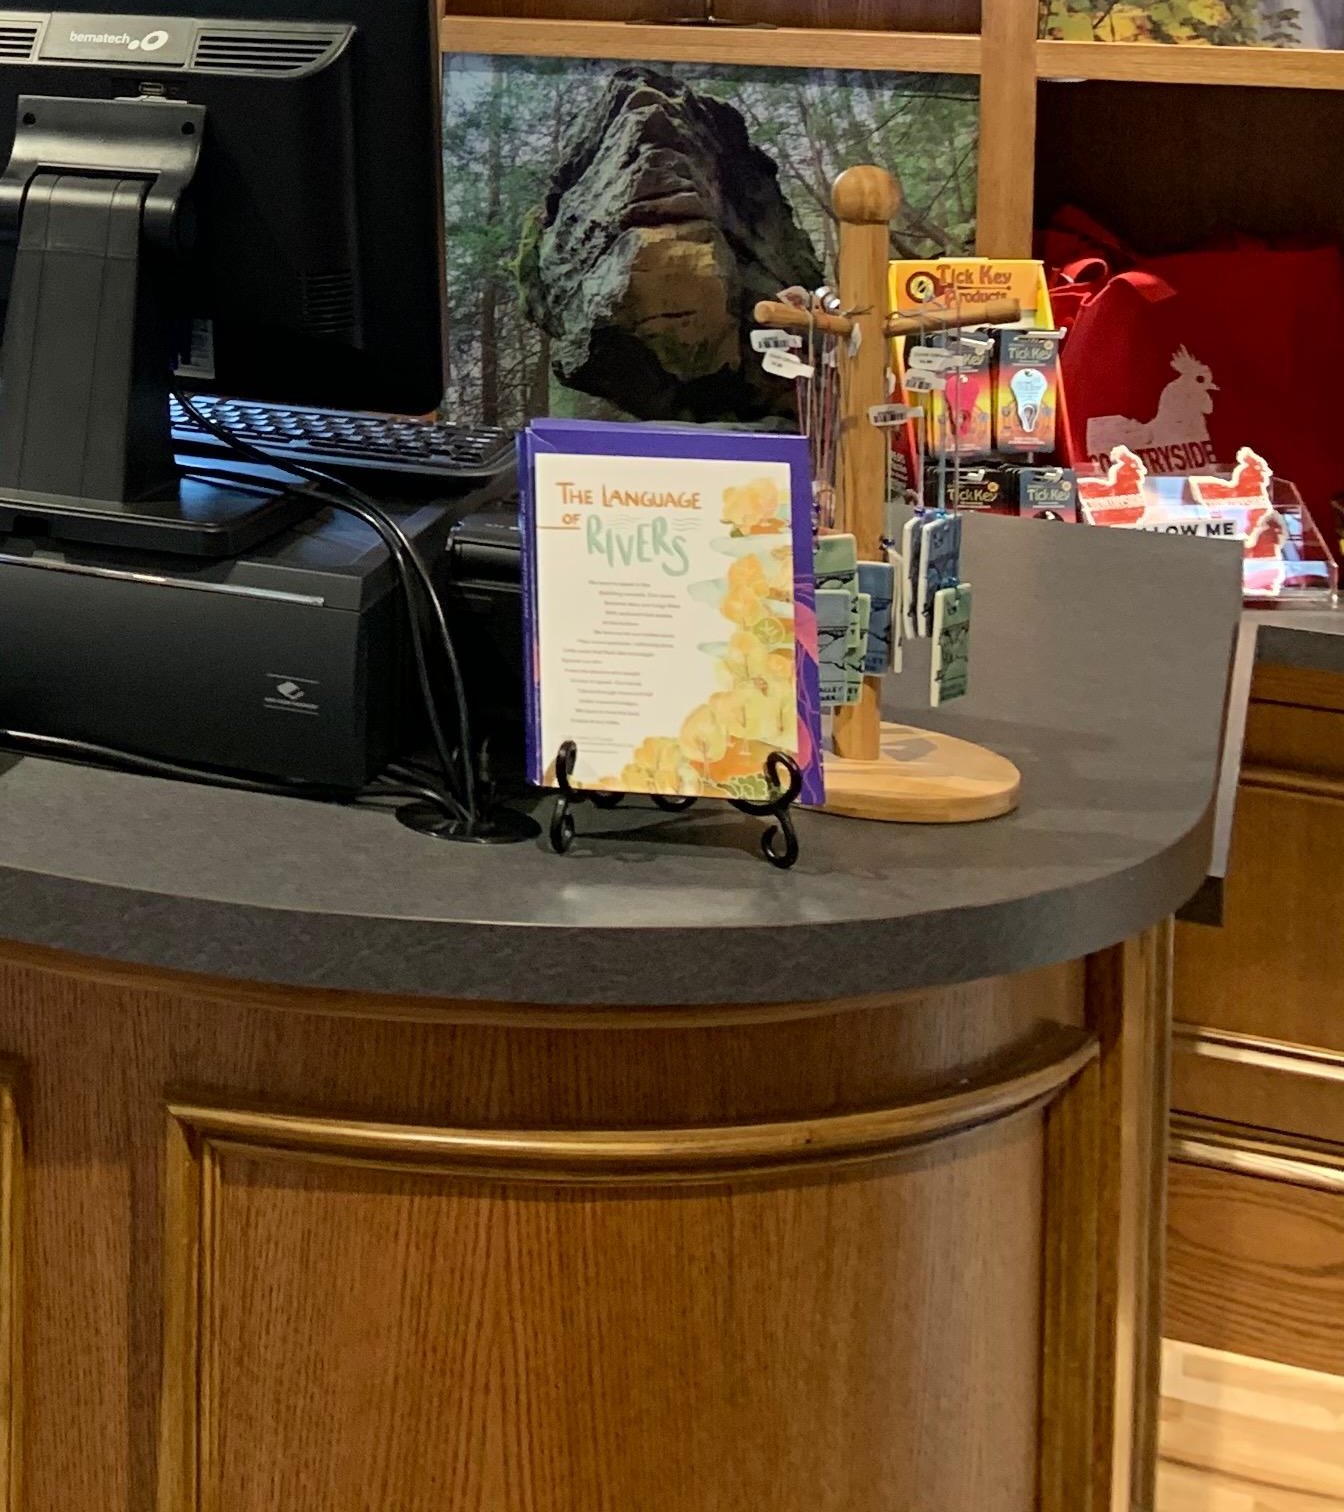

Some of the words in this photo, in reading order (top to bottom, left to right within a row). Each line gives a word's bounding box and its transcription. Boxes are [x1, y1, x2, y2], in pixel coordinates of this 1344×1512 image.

[68, 30, 131, 46] bematech
[936, 264, 974, 285] Tick
[979, 264, 1012, 285] Key
[943, 289, 1007, 309] Products
[1088, 440, 1217, 474] COTRYSIDE
[1205, 522, 1235, 536] ME
[585, 513, 691, 578] RIVERS
